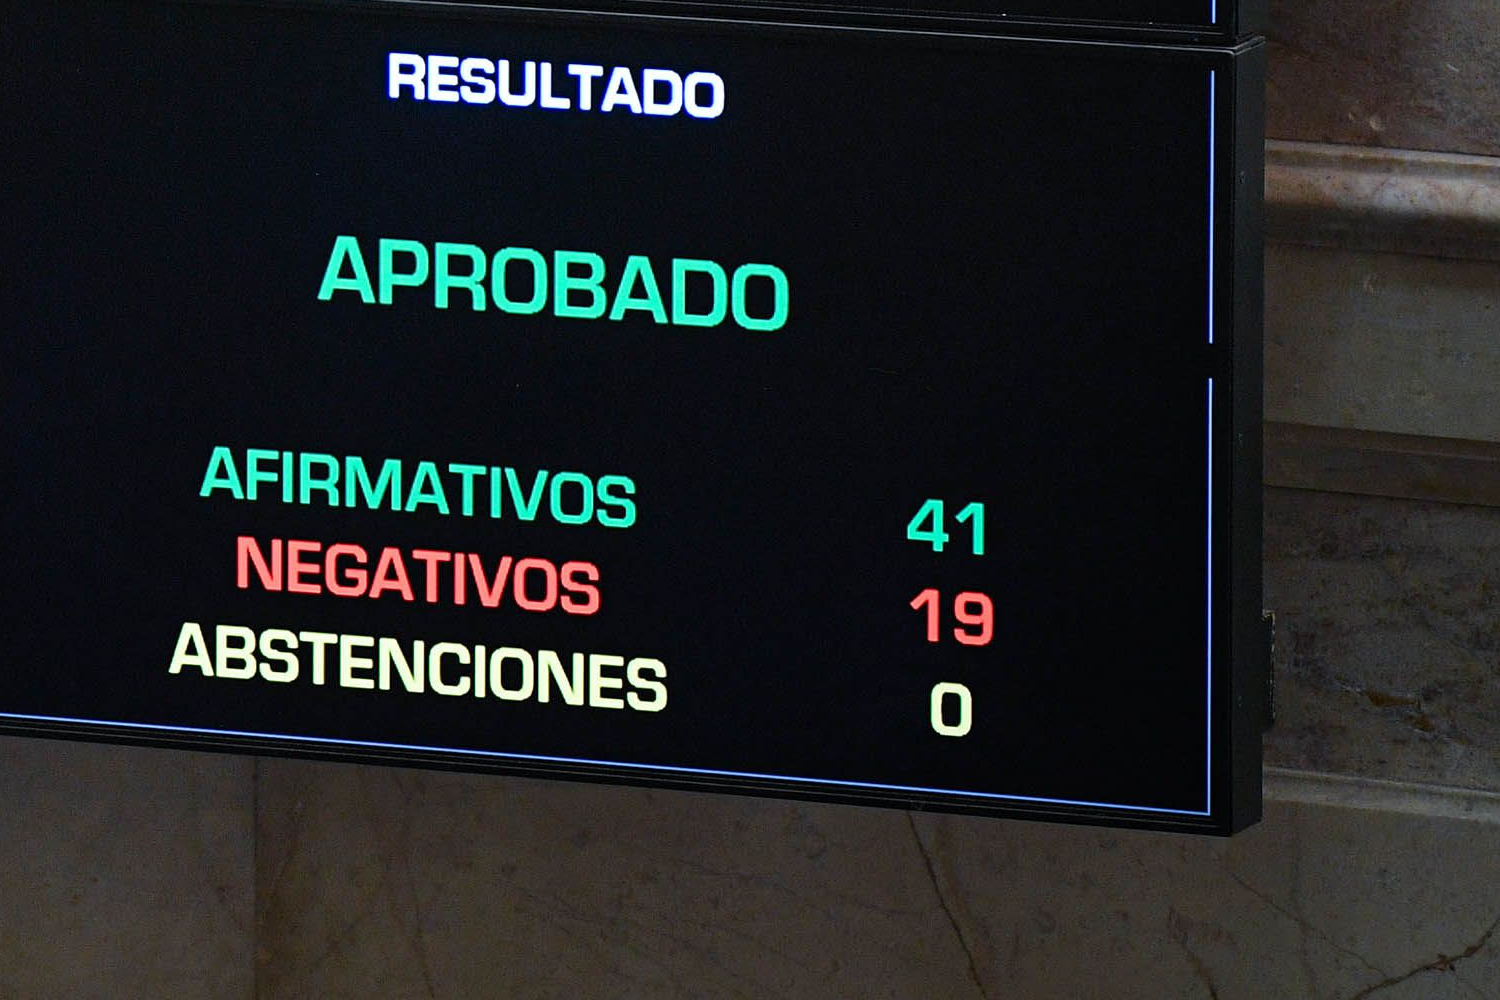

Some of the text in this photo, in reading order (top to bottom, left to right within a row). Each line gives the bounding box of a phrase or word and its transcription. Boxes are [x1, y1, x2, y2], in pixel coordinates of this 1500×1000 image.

[388, 52, 725, 119] RESULTADO
[317, 235, 790, 332] APROBADO
[199, 445, 985, 556] AFIRMATIVOS 41
[236, 535, 994, 646] NEGATIVOS 19
[168, 622, 973, 737] ABSTENCIONES 0
